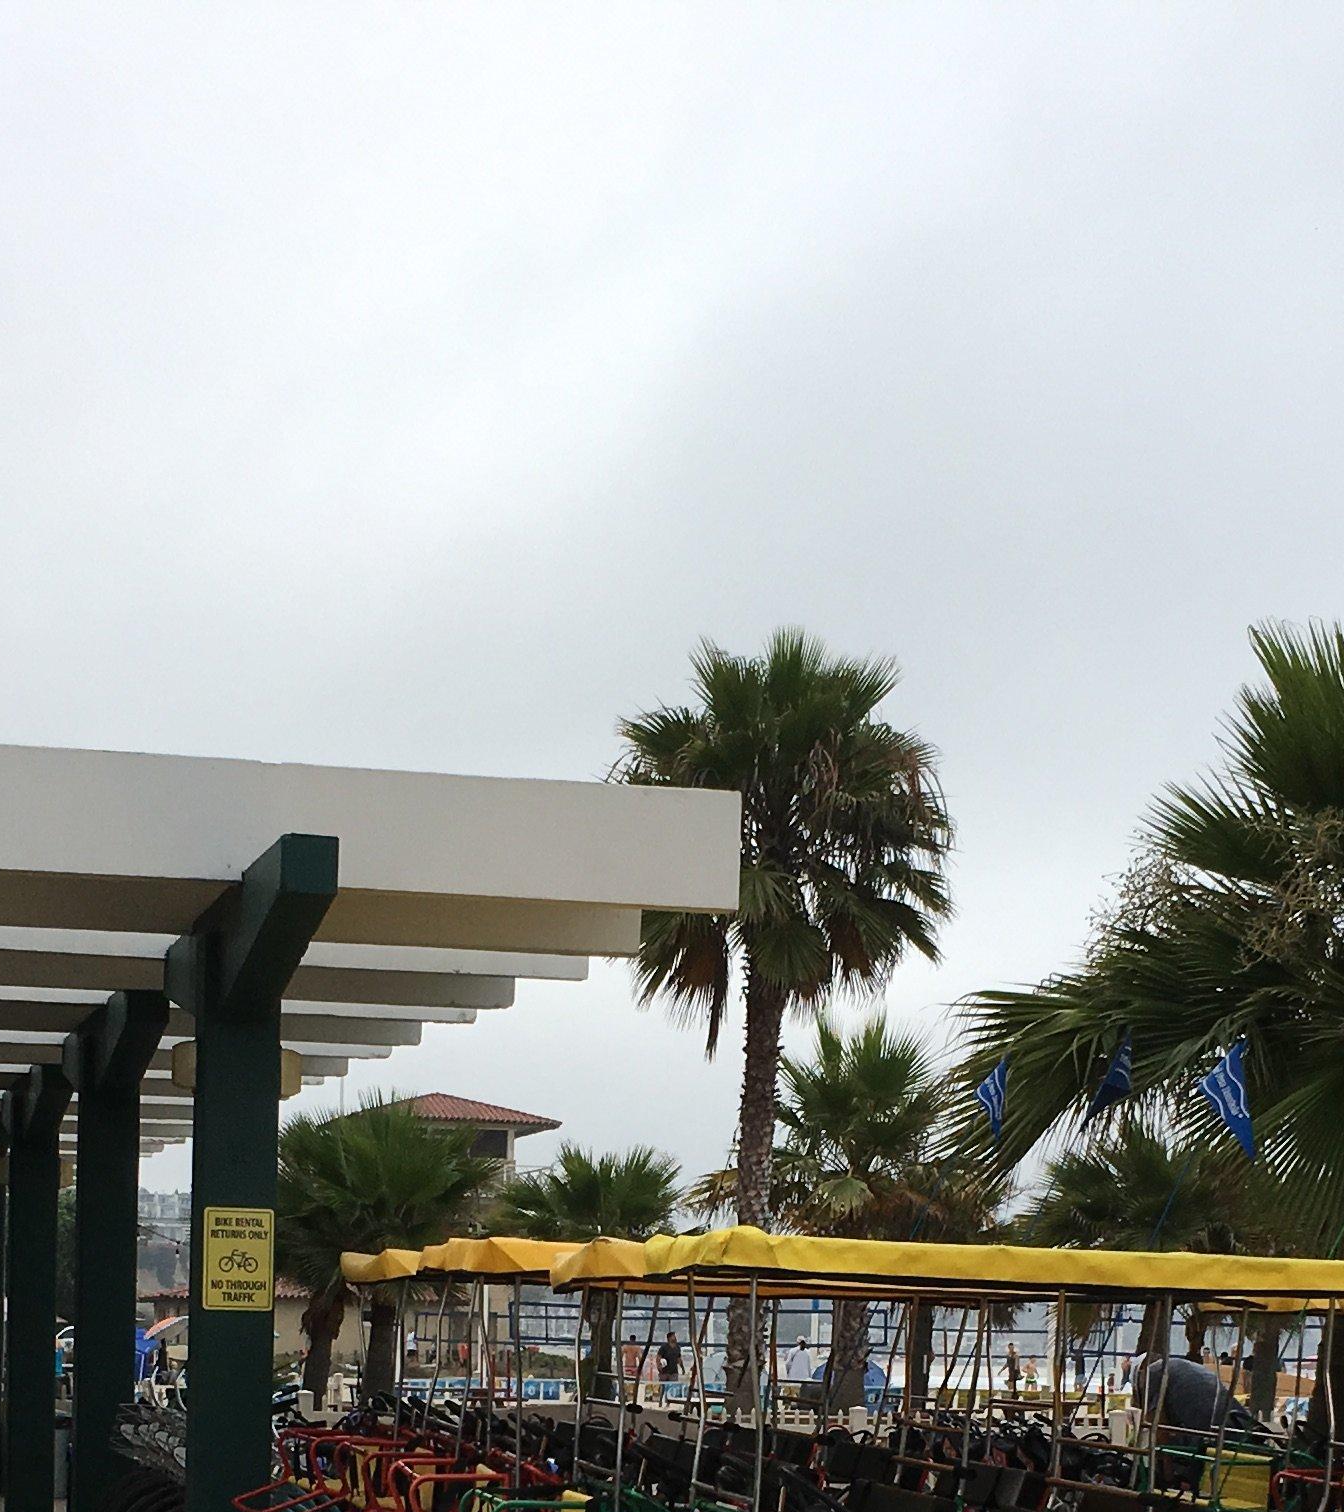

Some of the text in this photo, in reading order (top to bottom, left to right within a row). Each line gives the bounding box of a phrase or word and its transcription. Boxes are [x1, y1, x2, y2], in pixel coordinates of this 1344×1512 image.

[215, 1217, 264, 1228] BIKE RENTAL
[210, 1229, 269, 1240] RETURNS ONLY
[211, 1279, 267, 1291] NO THROUGH
[222, 1291, 256, 1303] TRAFFIC
